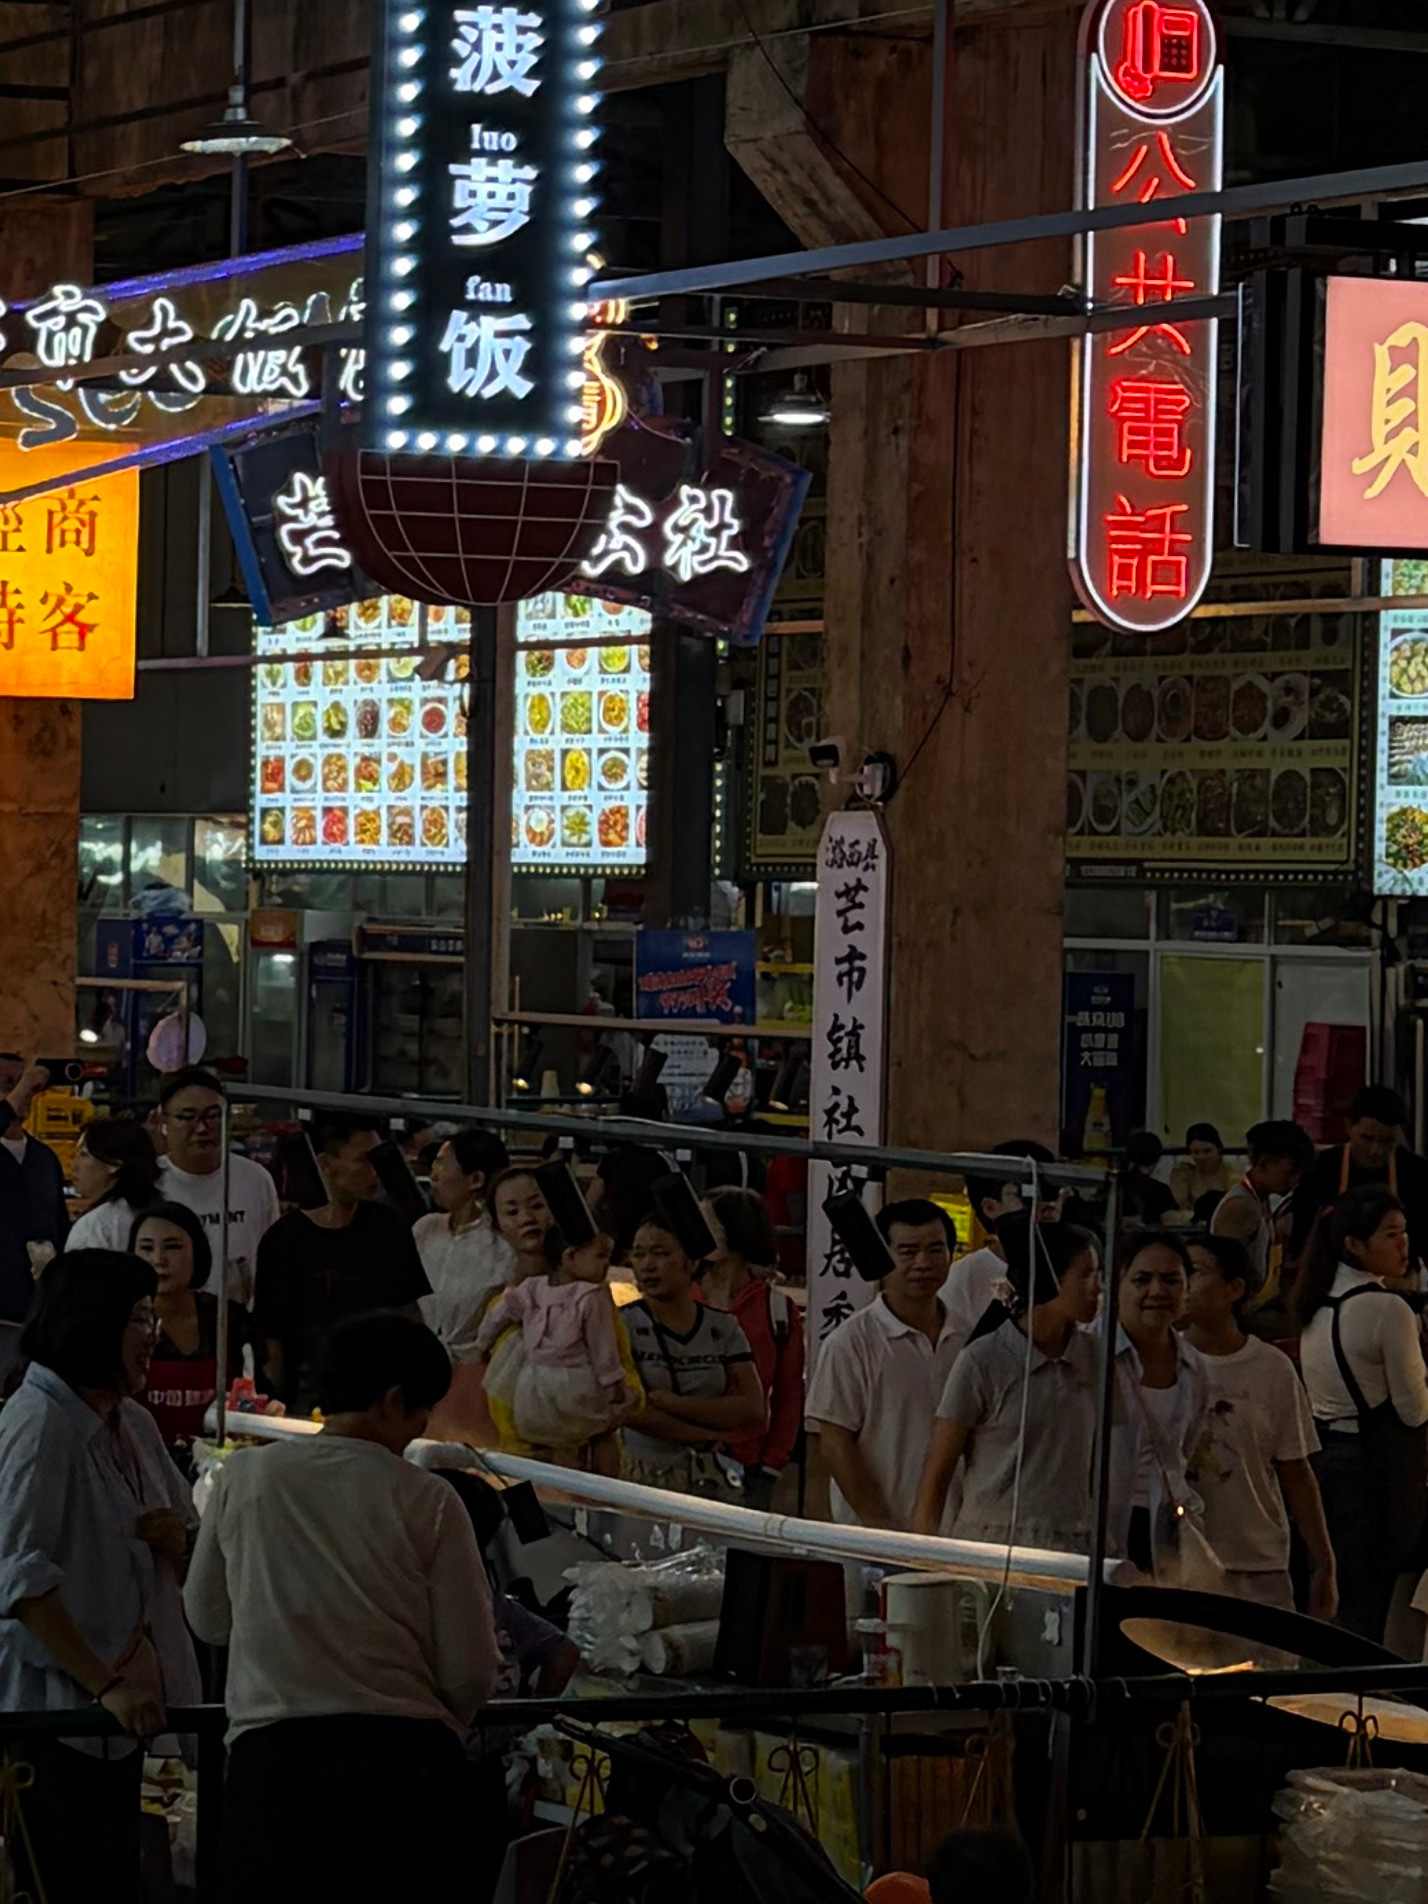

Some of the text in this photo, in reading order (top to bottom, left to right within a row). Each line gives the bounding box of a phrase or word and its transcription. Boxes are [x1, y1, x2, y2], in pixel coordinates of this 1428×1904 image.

[439, 5, 546, 400] 菠萝饭
[470, 123, 517, 153] luo
[464, 274, 513, 303] fan
[1106, 131, 1197, 600] 公共電話
